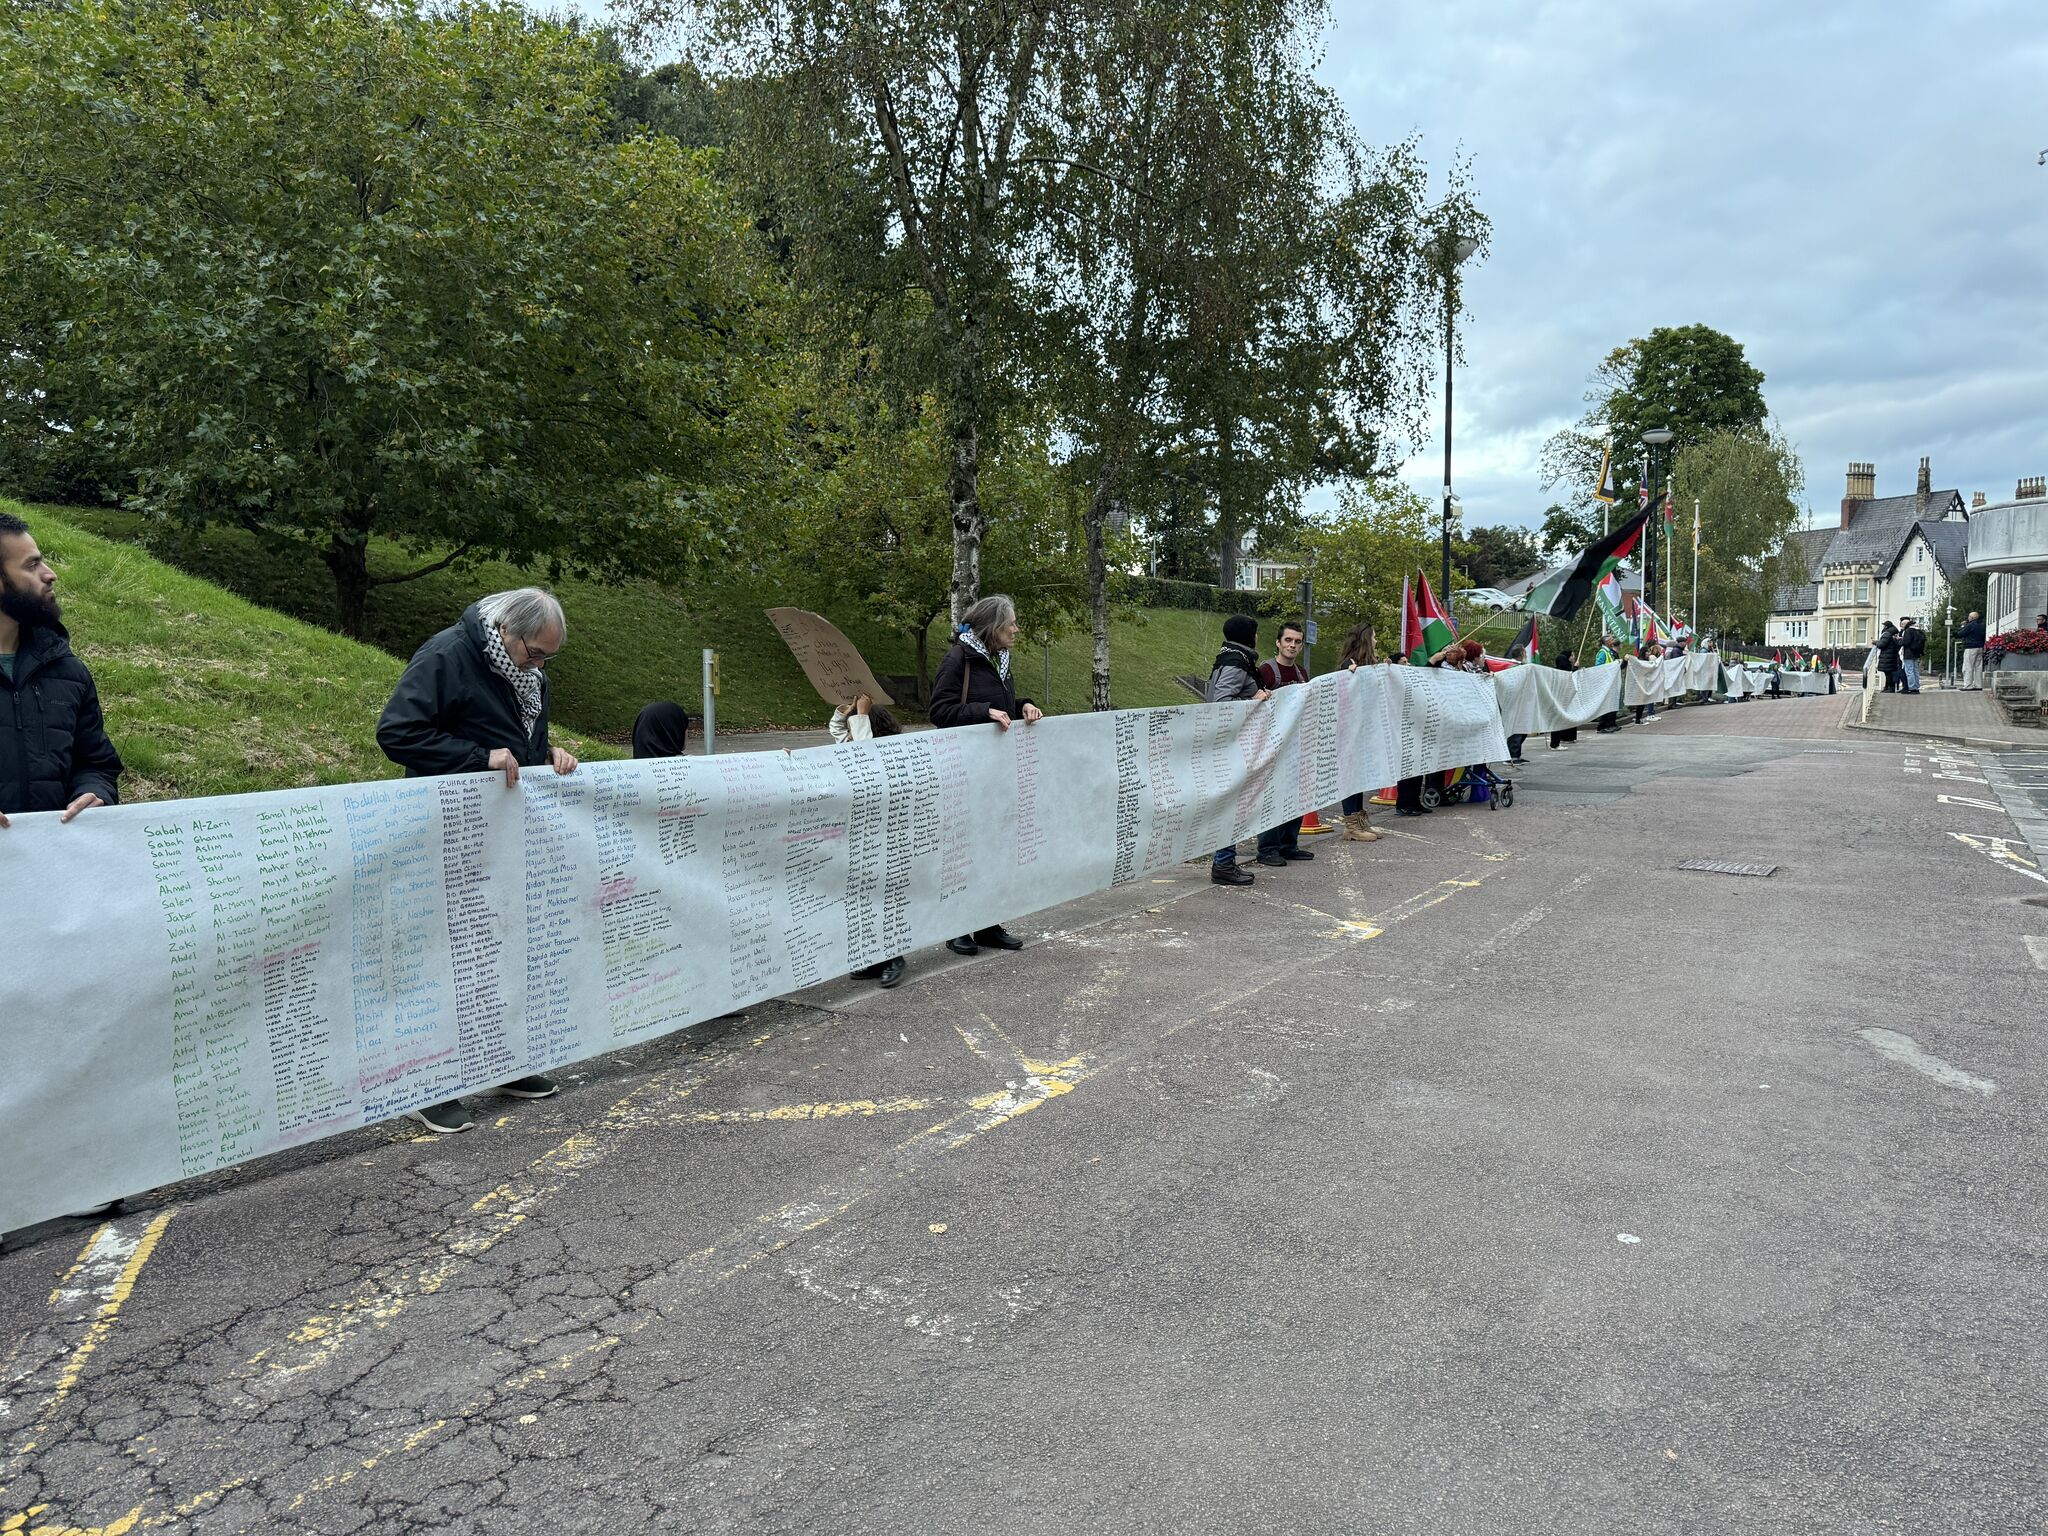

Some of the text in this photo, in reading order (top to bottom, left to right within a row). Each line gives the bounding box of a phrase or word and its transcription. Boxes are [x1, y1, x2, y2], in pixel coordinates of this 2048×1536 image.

[144, 823, 183, 837] Sabah
[147, 837, 184, 849] Sabah
[151, 849, 182, 858] Salwa
[161, 897, 193, 909] Salem
[169, 941, 196, 952] Zaki
